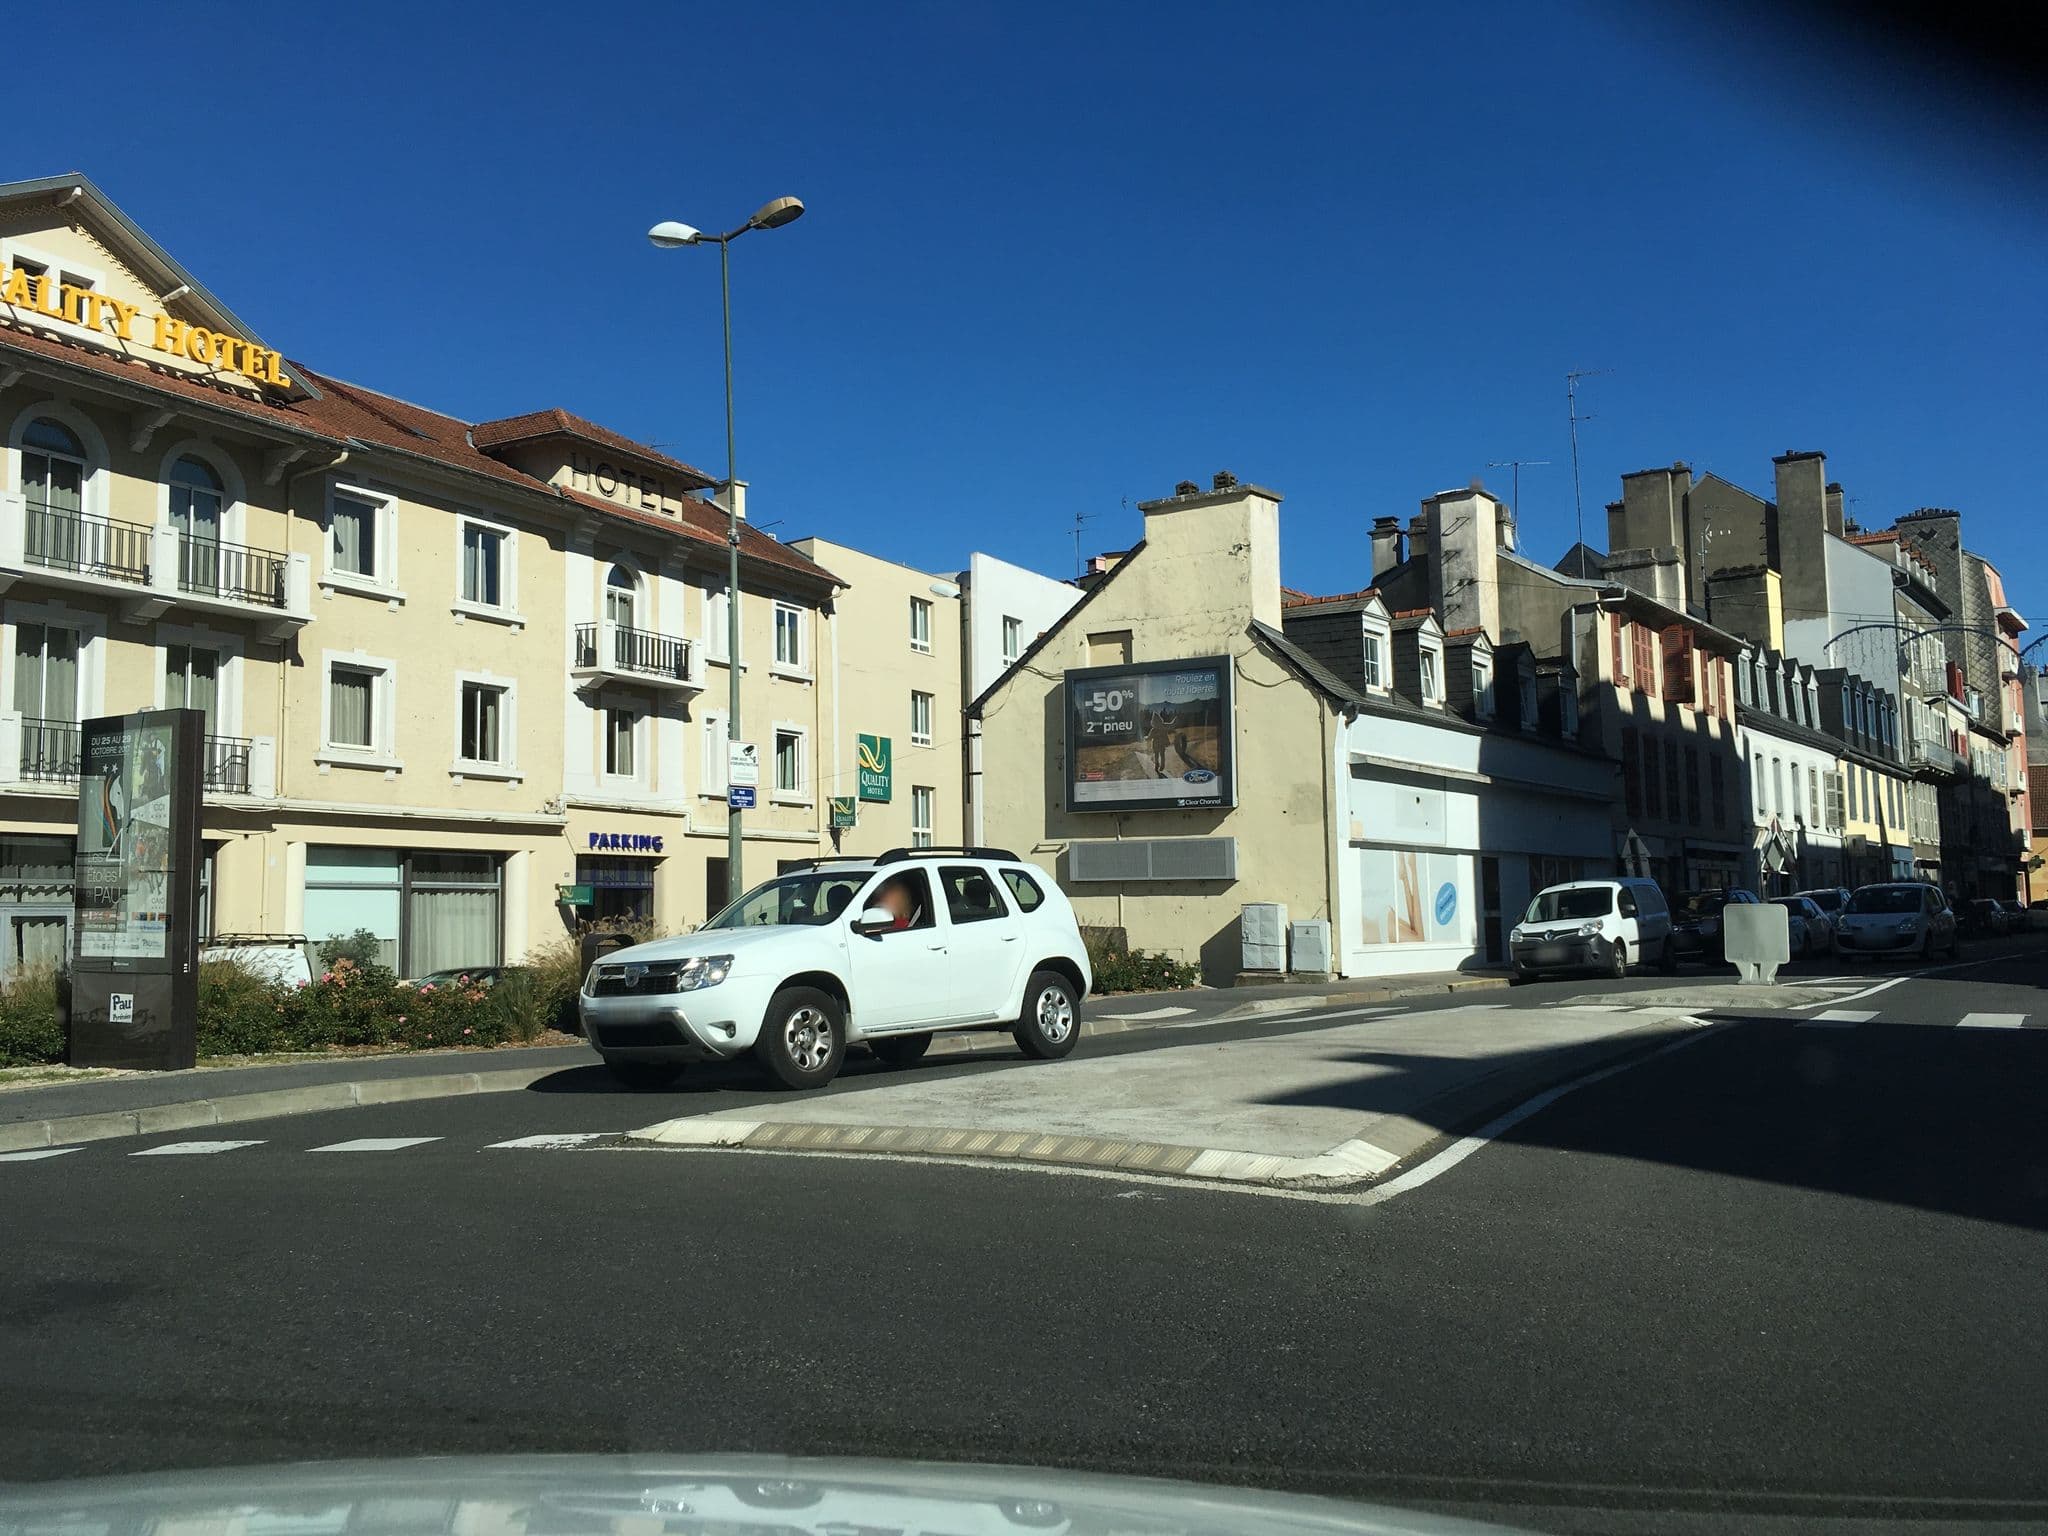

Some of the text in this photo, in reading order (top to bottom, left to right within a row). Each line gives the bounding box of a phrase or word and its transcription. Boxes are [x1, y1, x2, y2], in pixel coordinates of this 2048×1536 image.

[151, 313, 291, 388] HOTEL
[570, 452, 675, 517] HOTEL
[1085, 689, 1134, 712] -50%
[1103, 721, 1133, 734] pneu
[101, 736, 111, 745] 25
[861, 770, 889, 787] QUALITY
[1188, 772, 1209, 782] Ford
[867, 786, 884, 796] HOTEL
[588, 831, 664, 853] PARKING
[94, 886, 121, 904] PAU
[112, 994, 132, 1011] Pau
